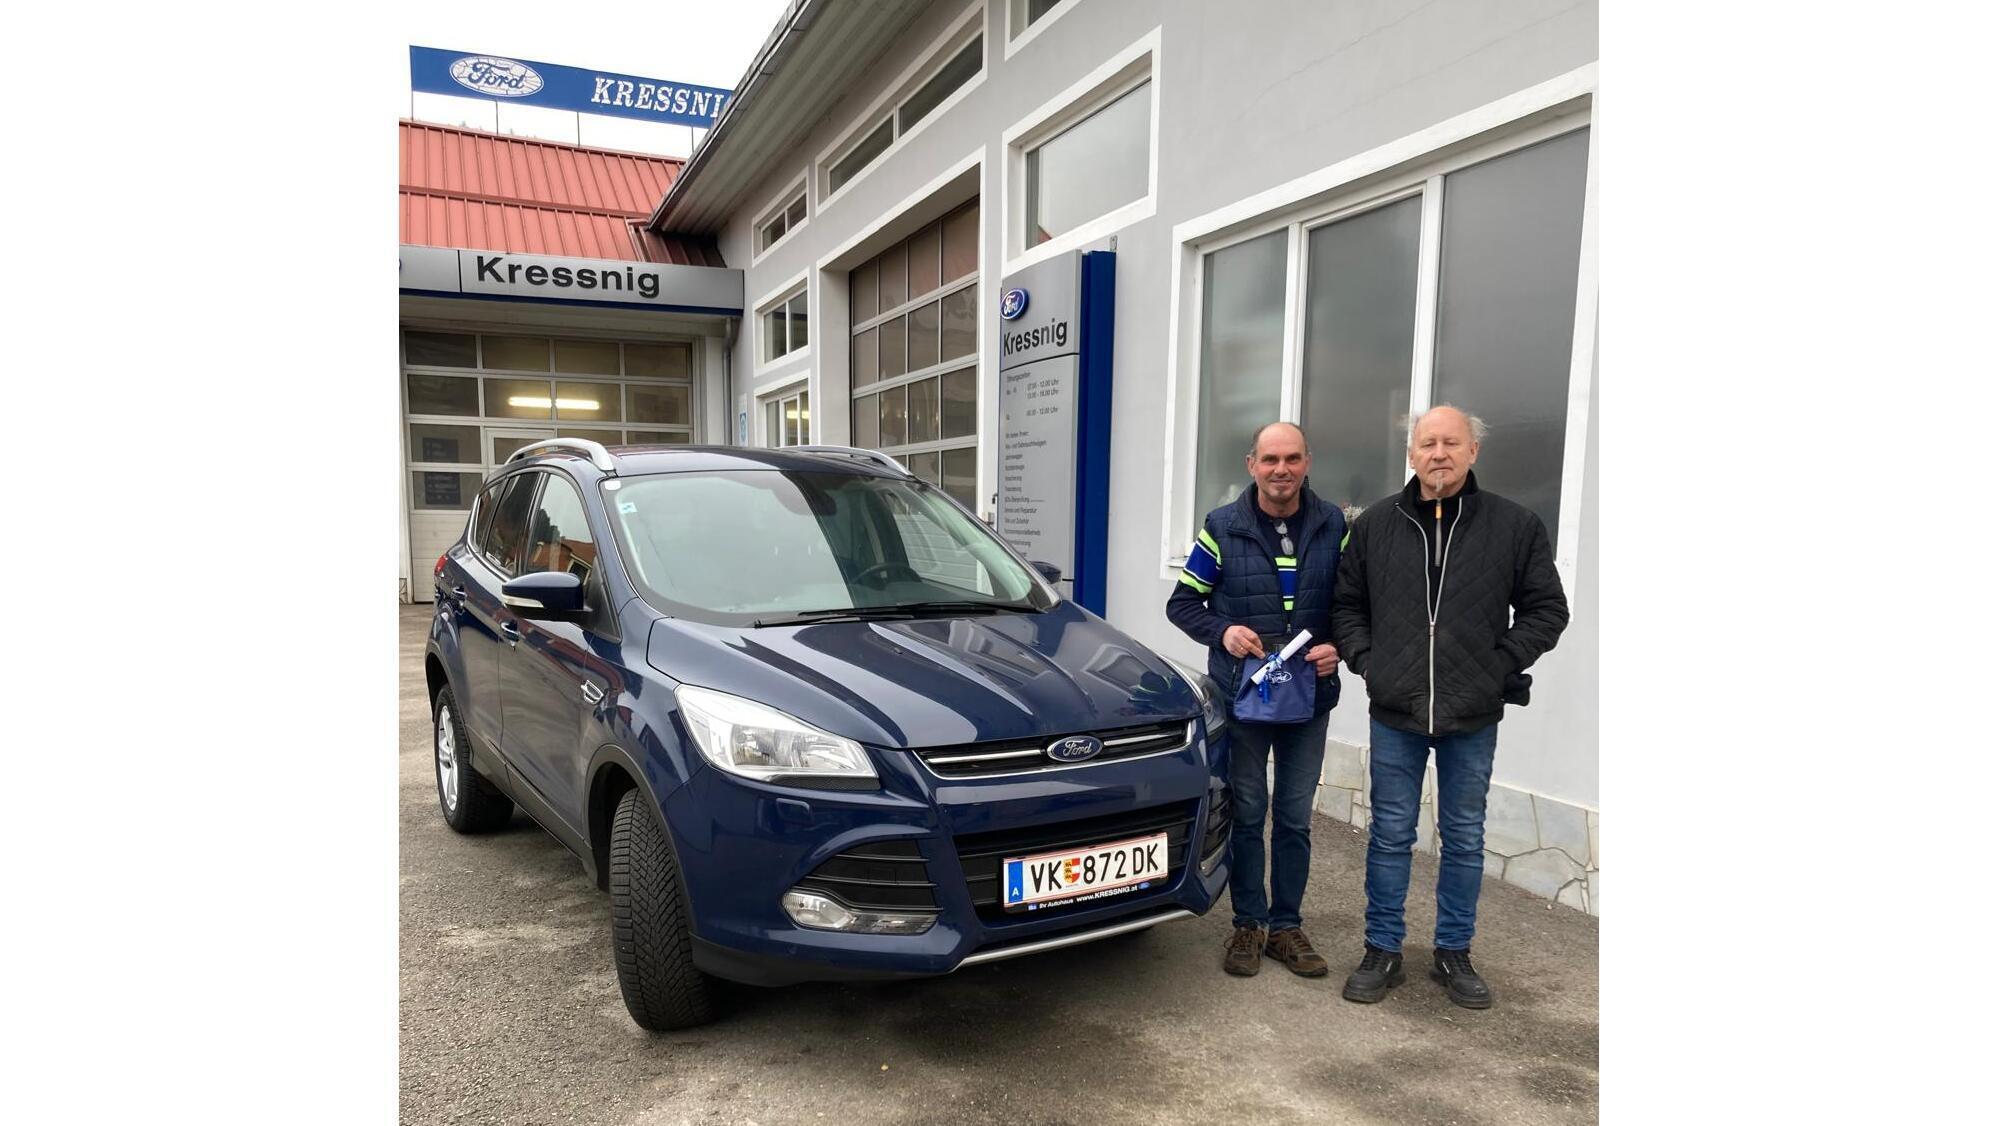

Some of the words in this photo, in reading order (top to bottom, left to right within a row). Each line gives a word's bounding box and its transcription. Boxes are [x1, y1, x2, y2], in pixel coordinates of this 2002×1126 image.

[466, 61, 525, 90] Ford
[590, 77, 731, 118] KRESSNI
[477, 255, 660, 299] Kressnig
[1003, 317, 1068, 357] Kressnig
[1063, 739, 1092, 757] Ford
[1011, 887, 1020, 897] A
[1030, 860, 1064, 894] VK
[1048, 898, 1074, 908] Autohaus
[1076, 885, 1138, 903] www.KRESSNIG.at
